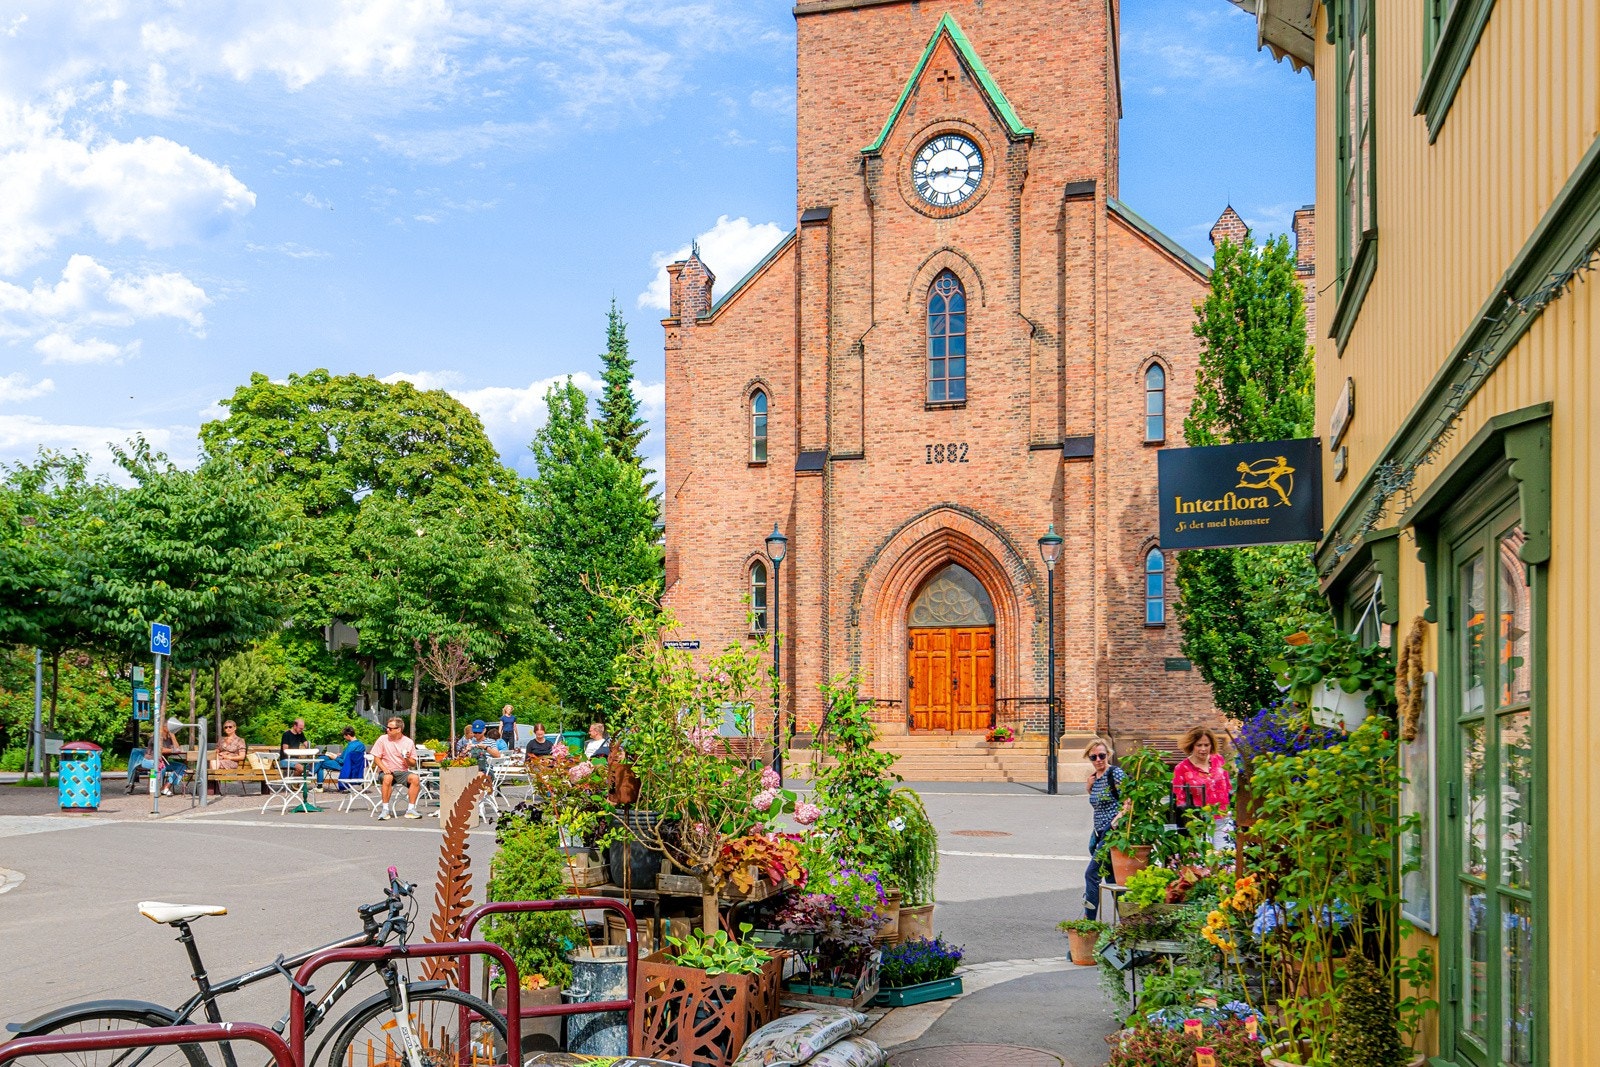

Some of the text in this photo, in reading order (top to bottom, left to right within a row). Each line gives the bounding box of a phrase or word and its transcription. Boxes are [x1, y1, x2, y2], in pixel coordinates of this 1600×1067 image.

[925, 442, 969, 464] 1882
[1175, 492, 1269, 514] Interflora
[1189, 520, 1204, 529] det
[1207, 518, 1227, 528] med
[1229, 517, 1270, 527] blomster
